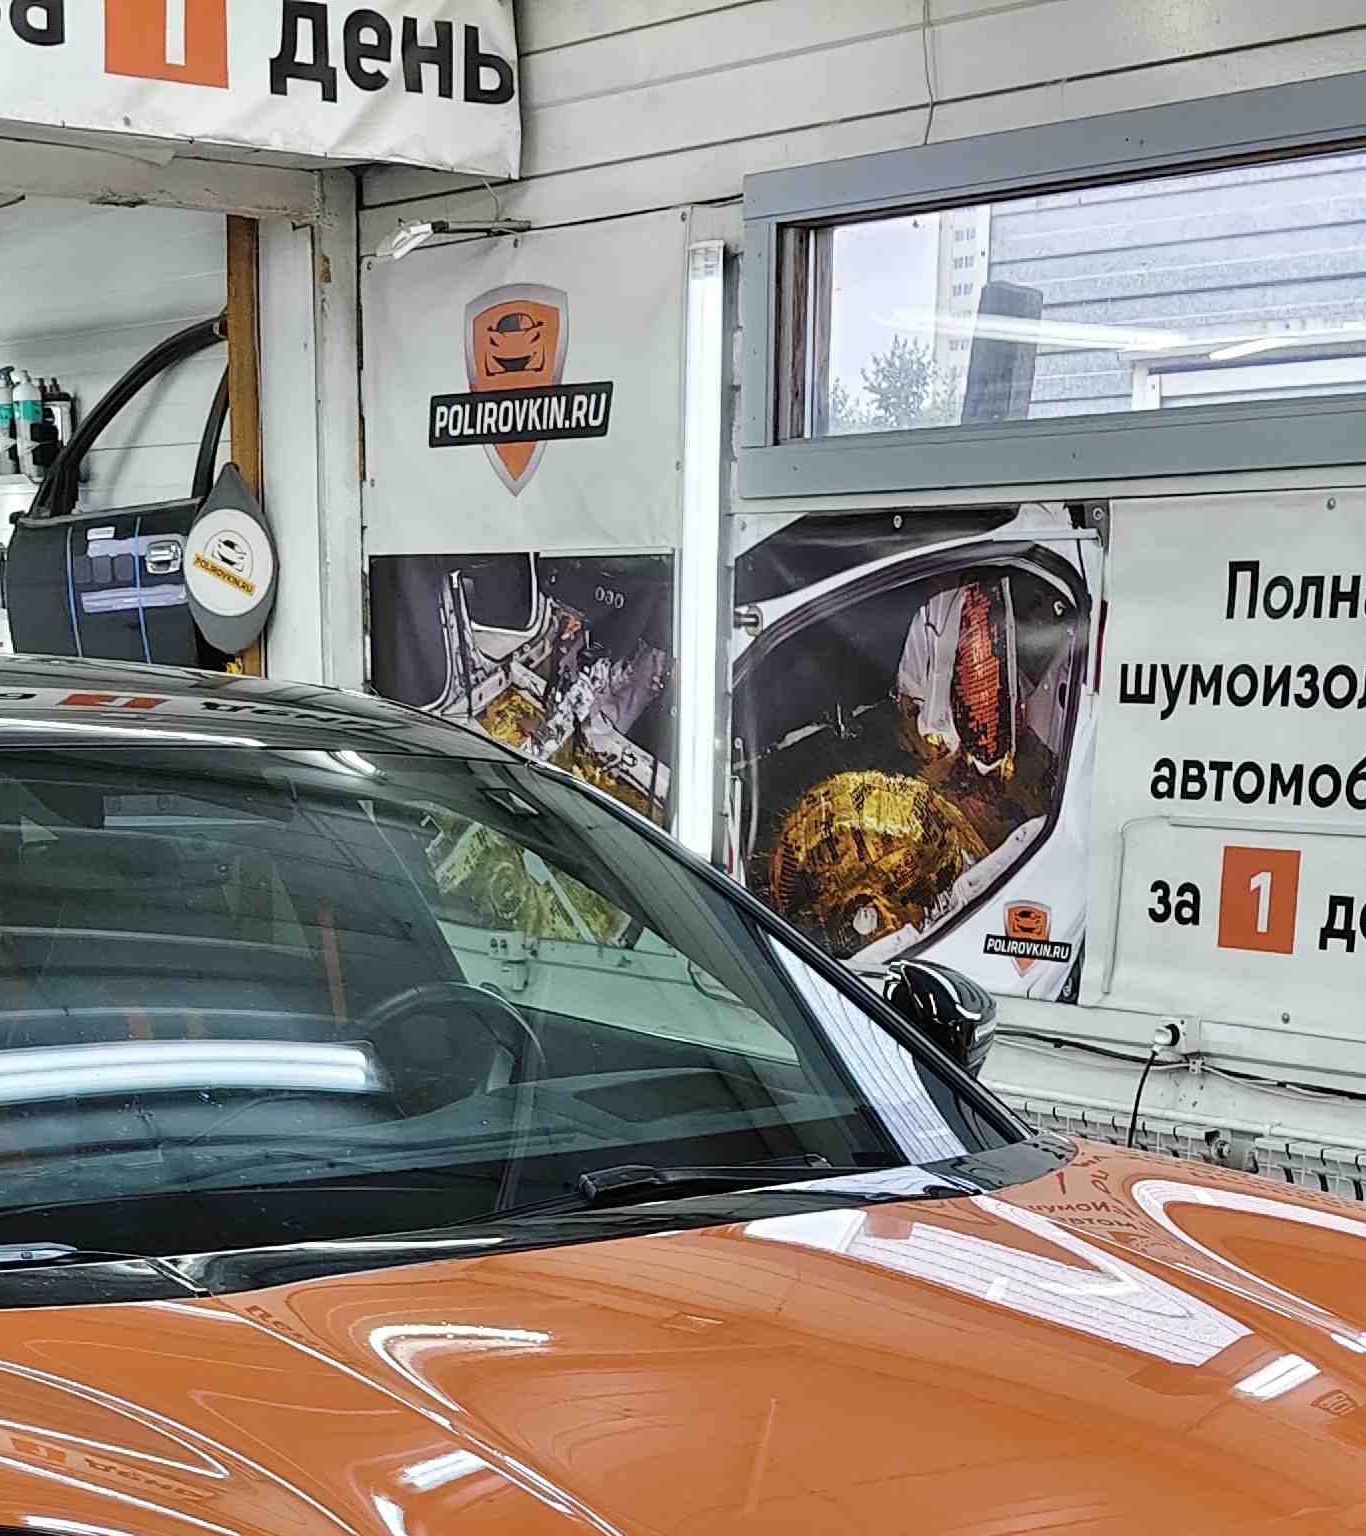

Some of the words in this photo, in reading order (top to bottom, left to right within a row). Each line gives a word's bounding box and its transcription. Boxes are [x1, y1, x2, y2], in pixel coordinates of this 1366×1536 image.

[269, 0, 515, 104] день
[434, 393, 607, 438] POLIROVKIN.RU
[1147, 879, 1201, 926] за
[1249, 871, 1273, 935] 1
[986, 938, 1070, 959] POLIROVKIN.RU
